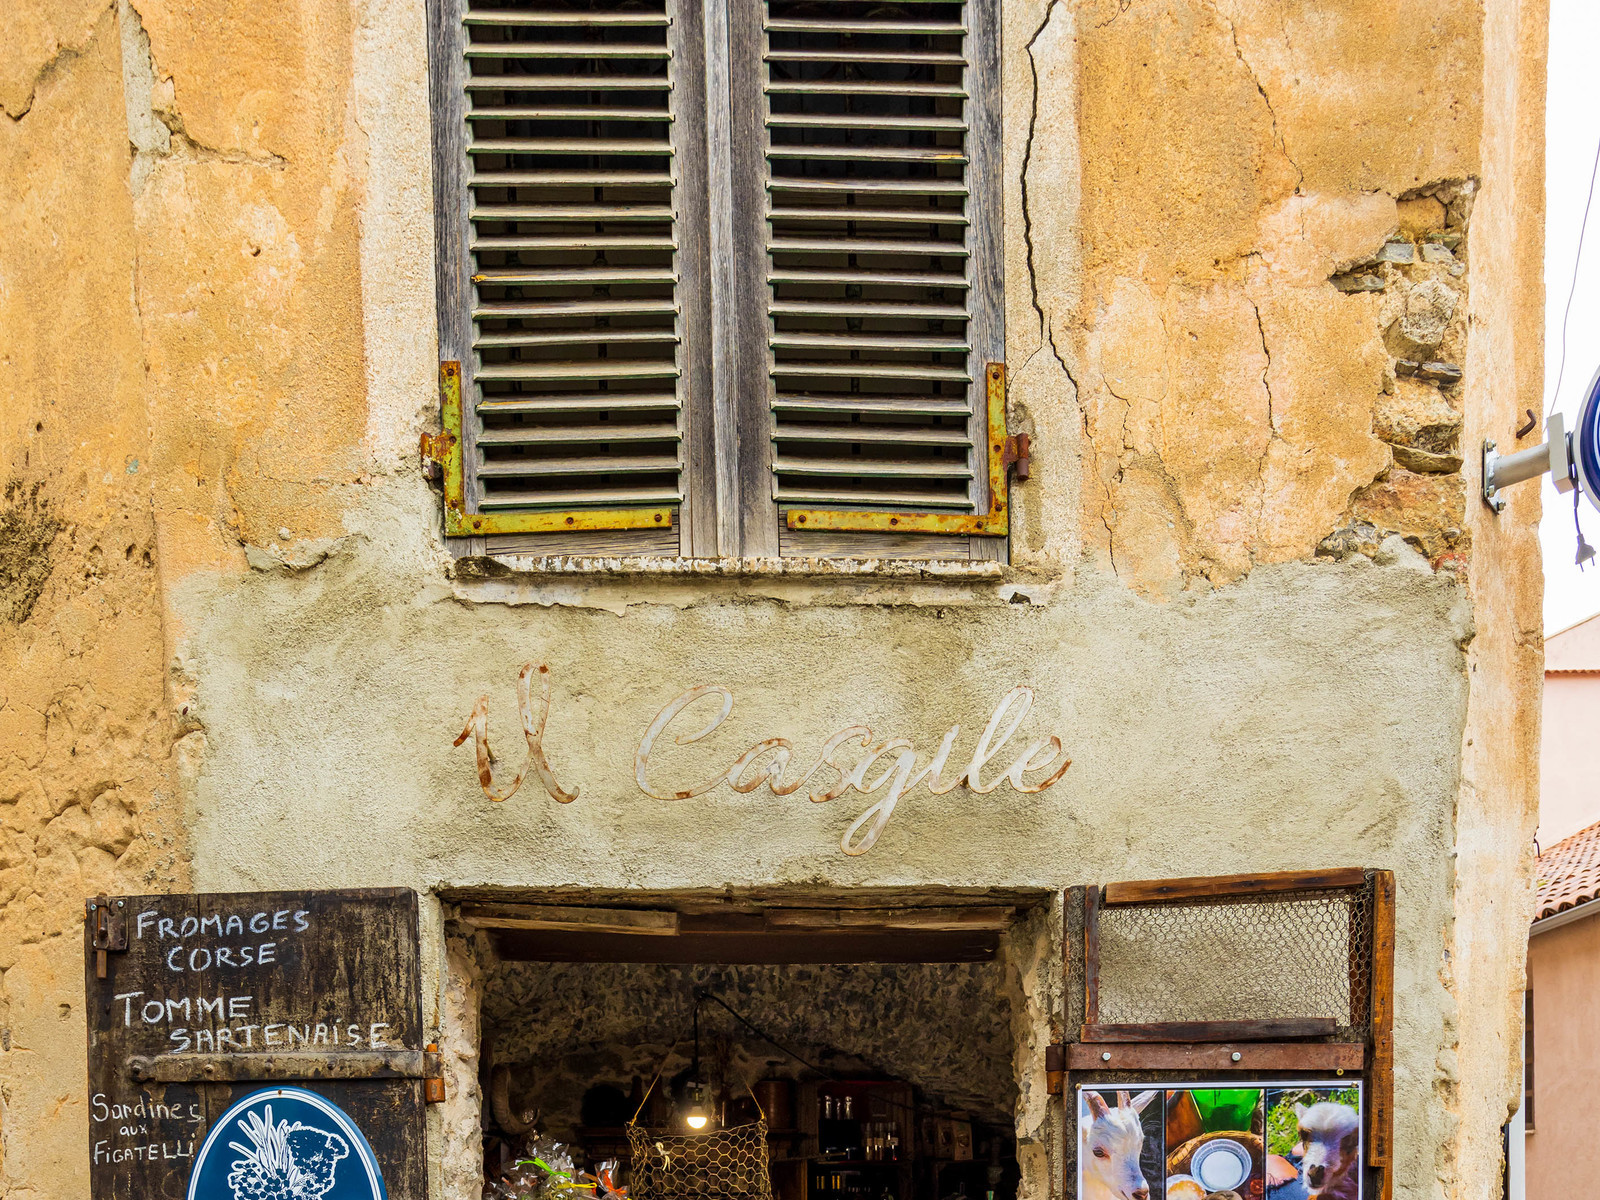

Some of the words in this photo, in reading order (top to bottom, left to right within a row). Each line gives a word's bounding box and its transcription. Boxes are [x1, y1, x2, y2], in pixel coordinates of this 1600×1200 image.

[634, 685, 1072, 856] Casgile
[137, 910, 310, 939] FROMAGES
[168, 943, 276, 972] CORSE
[114, 992, 253, 1027] TOMME
[92, 1093, 205, 1123] Sardines
[119, 1124, 148, 1136] aux
